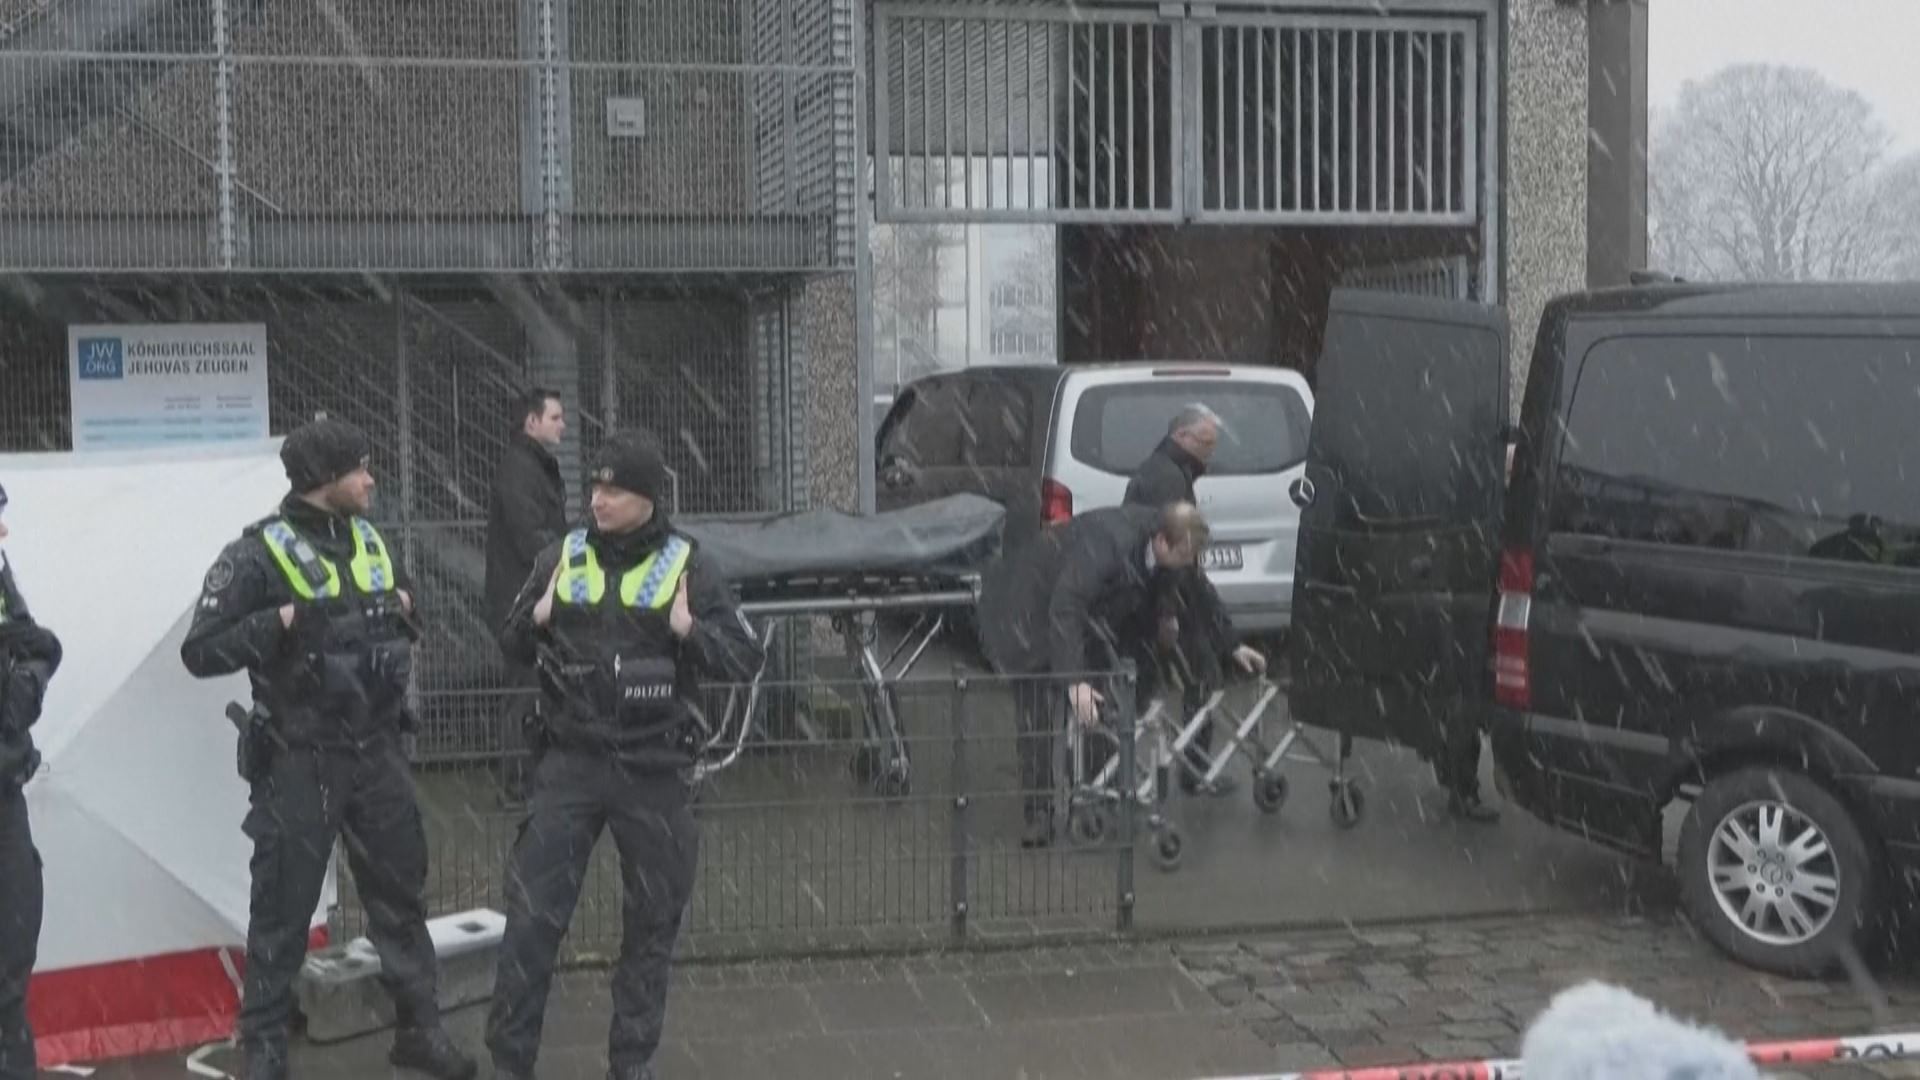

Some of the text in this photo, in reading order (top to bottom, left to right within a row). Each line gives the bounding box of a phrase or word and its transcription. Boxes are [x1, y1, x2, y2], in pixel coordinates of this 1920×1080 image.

[89, 341, 114, 358] JW
[127, 341, 255, 357] KÖNIGREICHSSAAL
[128, 358, 248, 375] JEHOVAS ZEUGEN
[624, 683, 672, 699] POLIZEI
